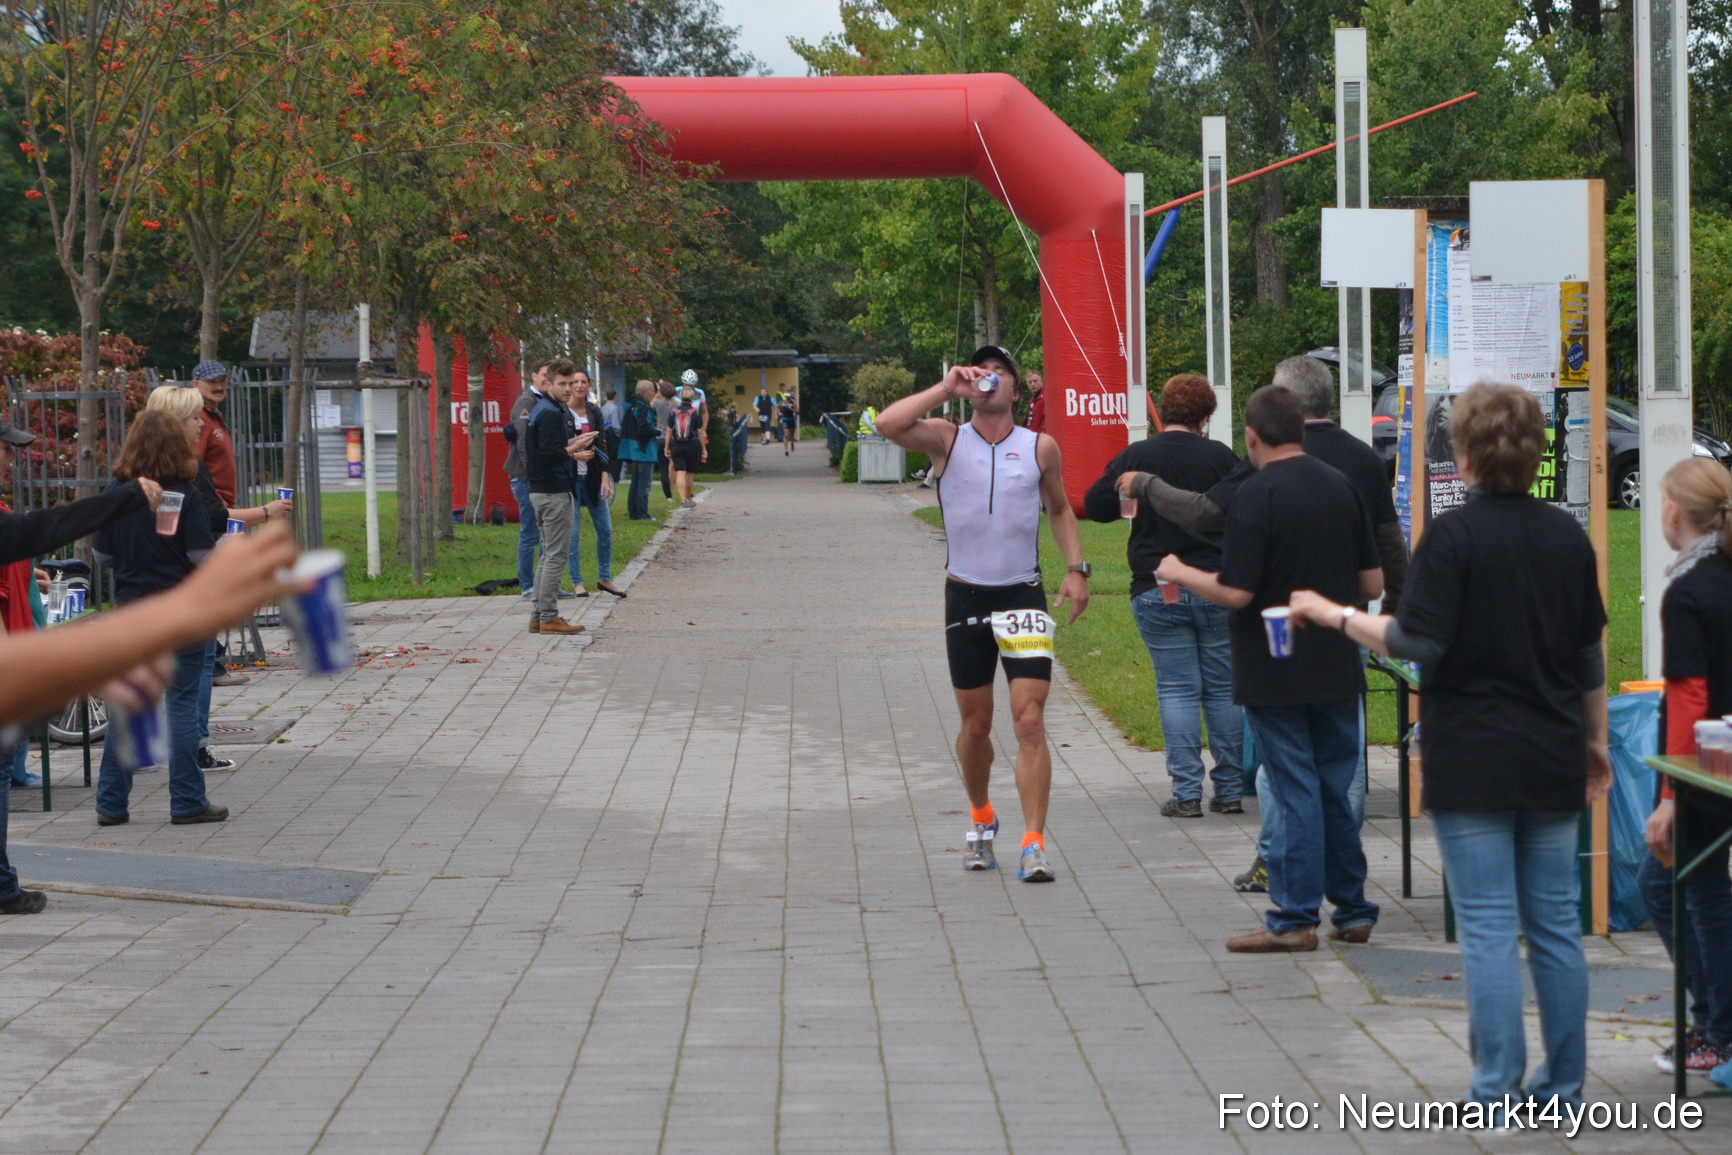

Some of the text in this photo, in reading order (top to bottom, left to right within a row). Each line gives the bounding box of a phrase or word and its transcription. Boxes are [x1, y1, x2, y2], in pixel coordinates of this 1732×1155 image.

[1511, 371, 1549, 380] NEUMARKT
[1065, 388, 1127, 417] Braun
[450, 401, 500, 424] ran
[1090, 417, 1109, 426] Sicher
[1109, 417, 1117, 425] ist
[1431, 494, 1453, 502] Funky
[1006, 613, 1047, 635] 345
[1003, 639, 1050, 649] Christophe
